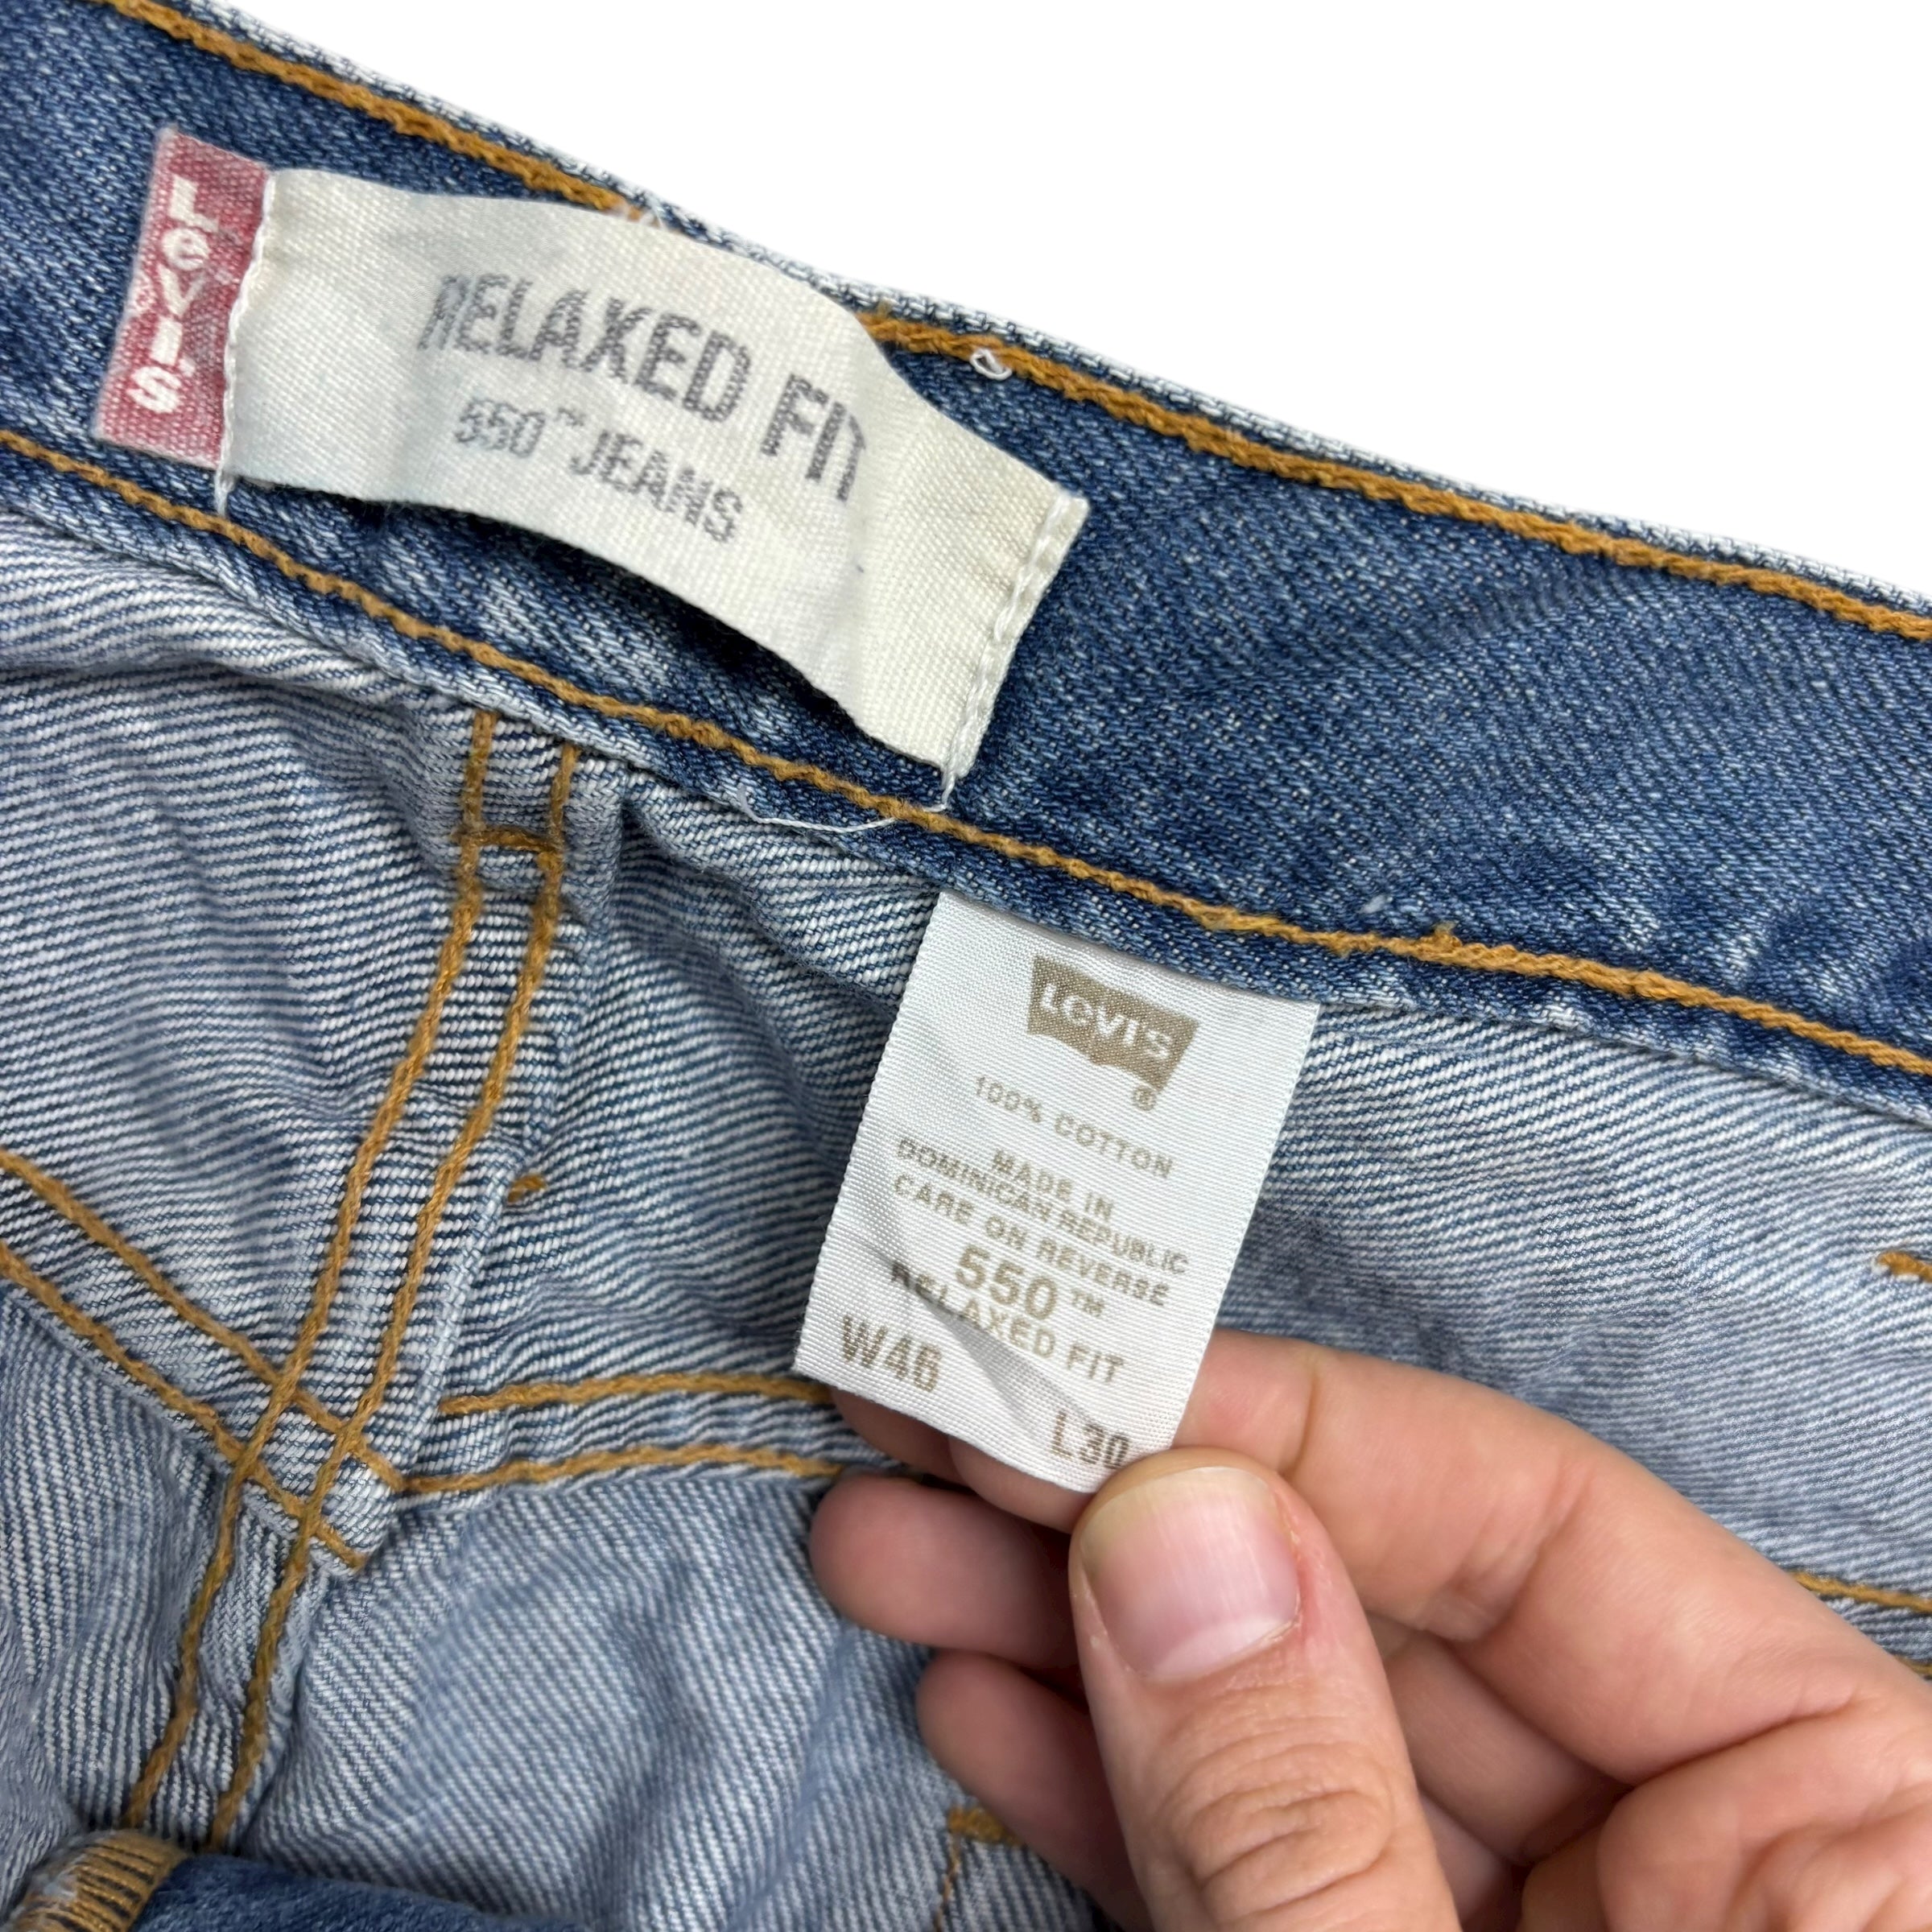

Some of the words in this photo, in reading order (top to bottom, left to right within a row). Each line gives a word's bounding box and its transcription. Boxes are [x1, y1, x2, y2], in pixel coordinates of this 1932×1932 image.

[416, 272, 752, 423] RELAXED
[568, 431, 743, 543] JEANS
[973, 1075, 1042, 1125] 100%
[1055, 1112, 1174, 1179] COTTON
[893, 1173, 975, 1225] CARE
[984, 1216, 1028, 1251] ON
[1036, 1236, 1170, 1307] REVERSE
[897, 1137, 1055, 1223] DOMINICAN
[1057, 1209, 1190, 1274] REPUBLIC
[993, 1149, 1073, 1202] MADE
[1085, 1191, 1115, 1223] IN
[841, 1314, 942, 1393] W46
[890, 1260, 1056, 1360] RELAXED
[1067, 1344, 1125, 1384] FIT
[1049, 1410, 1131, 1471] L30
